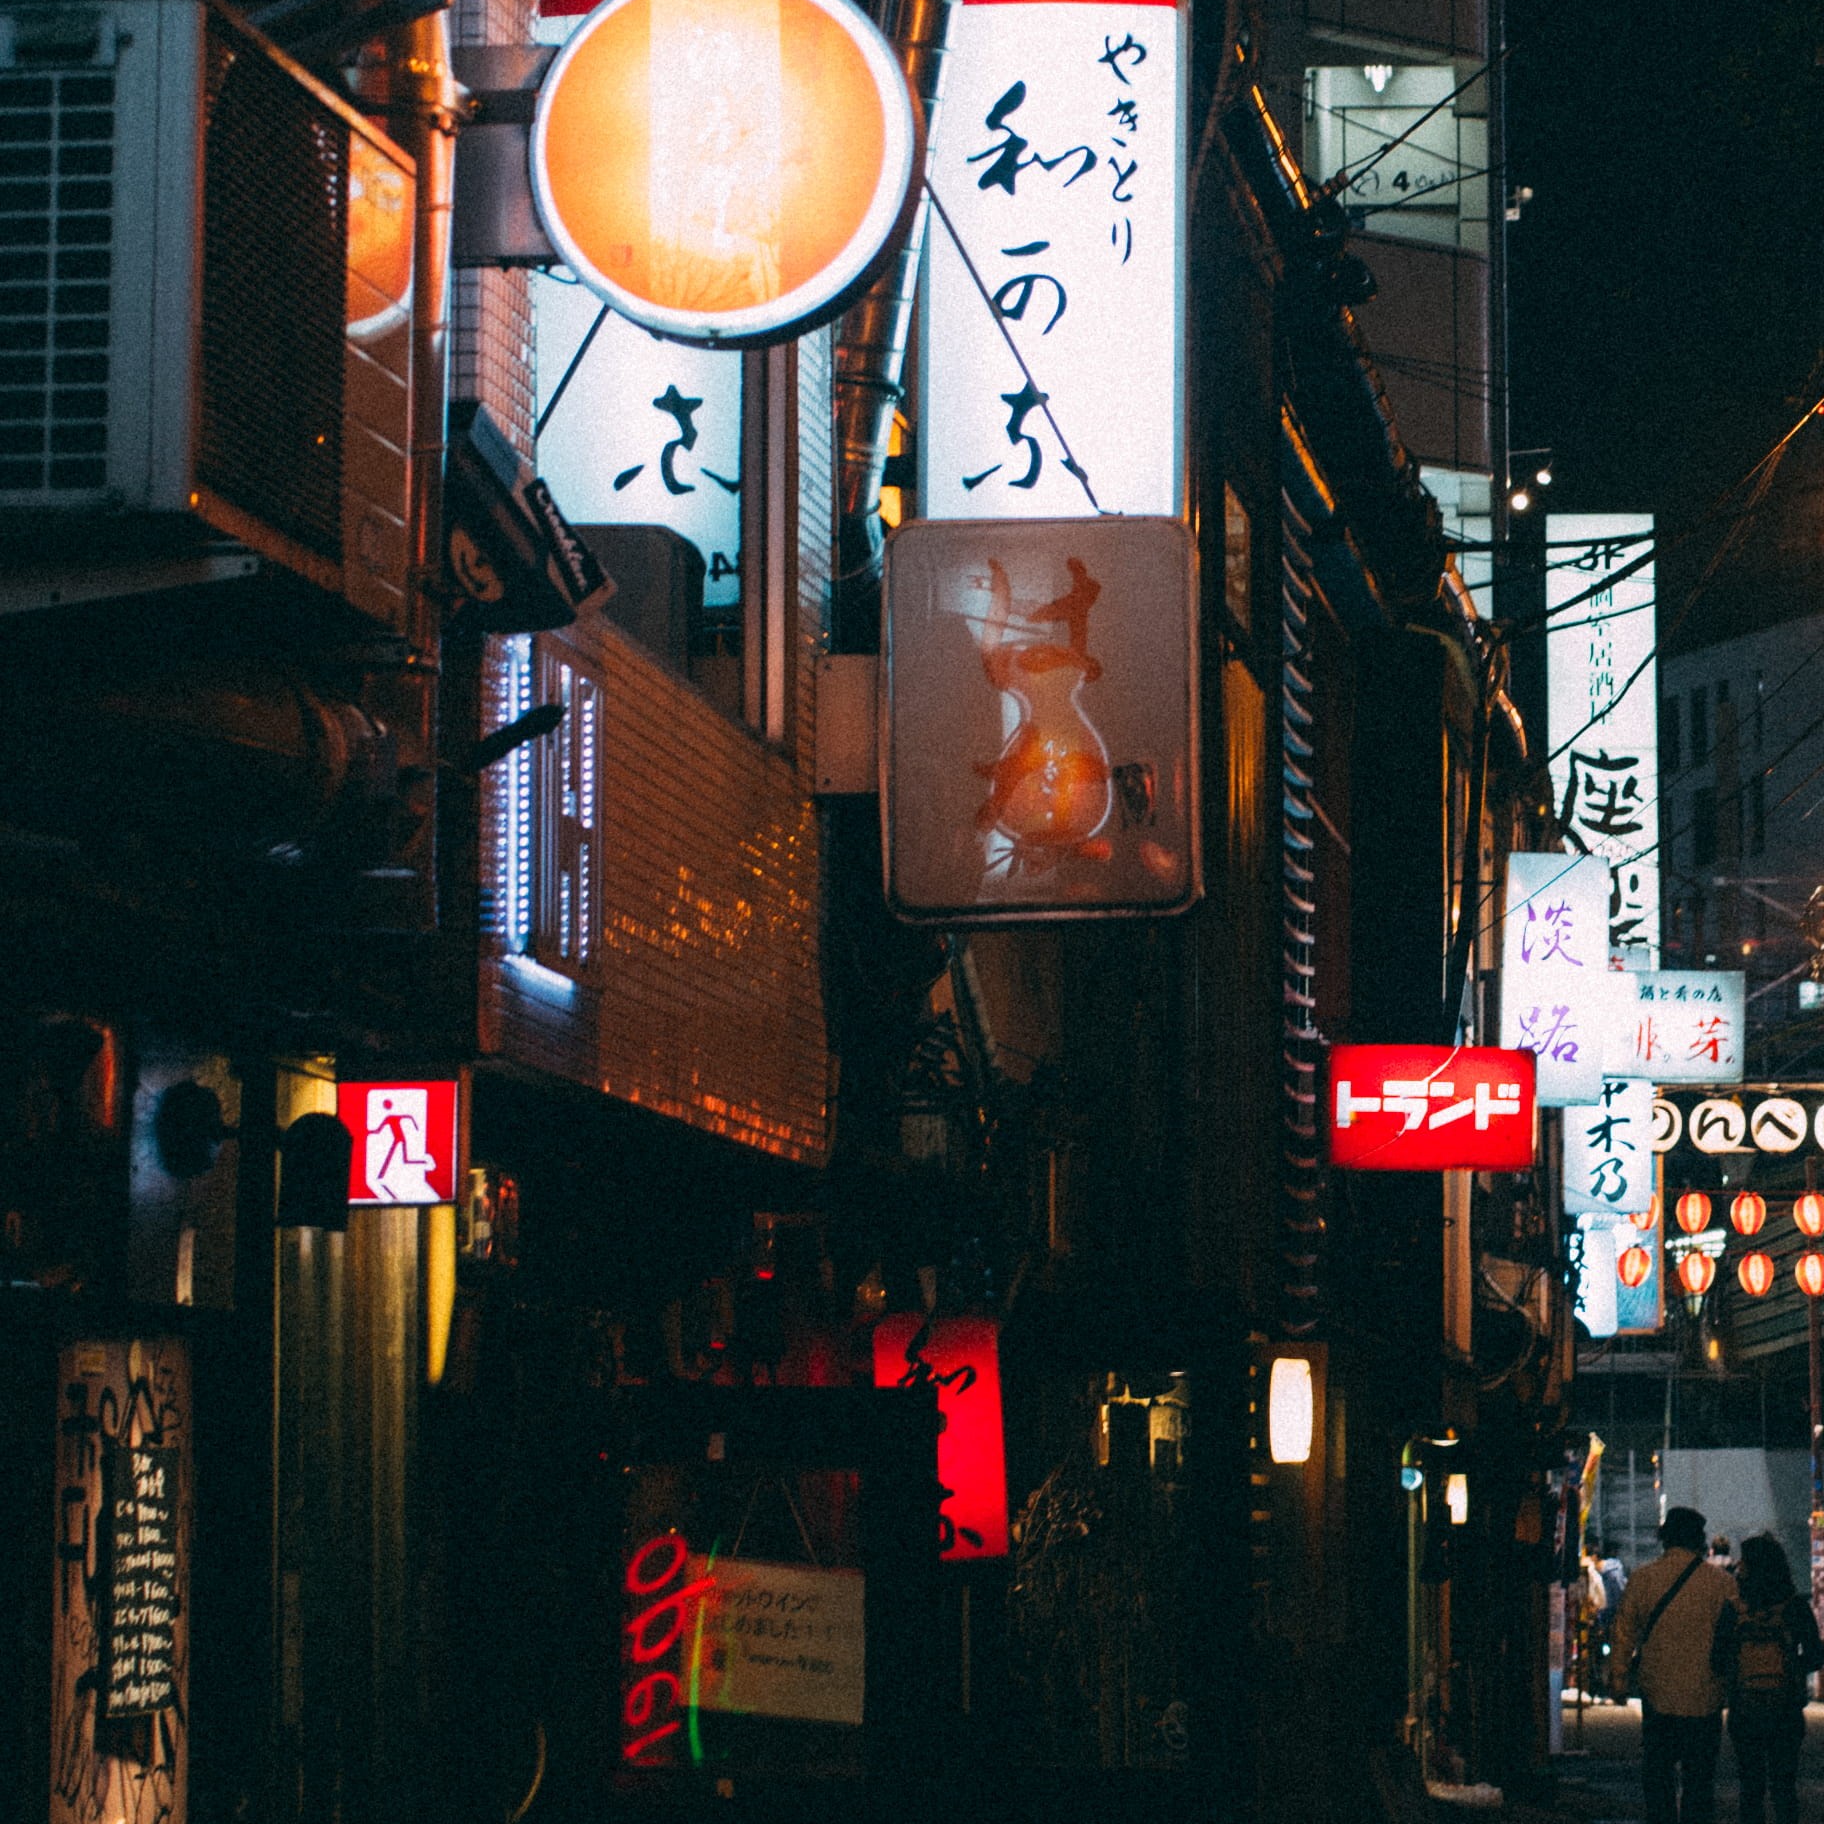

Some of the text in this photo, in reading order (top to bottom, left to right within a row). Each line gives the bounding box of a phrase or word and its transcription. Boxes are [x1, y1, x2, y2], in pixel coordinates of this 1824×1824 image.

[1098, 32, 1147, 266] やきとり
[1392, 171, 1409, 190] 4
[1336, 1080, 1521, 1131] トランド
